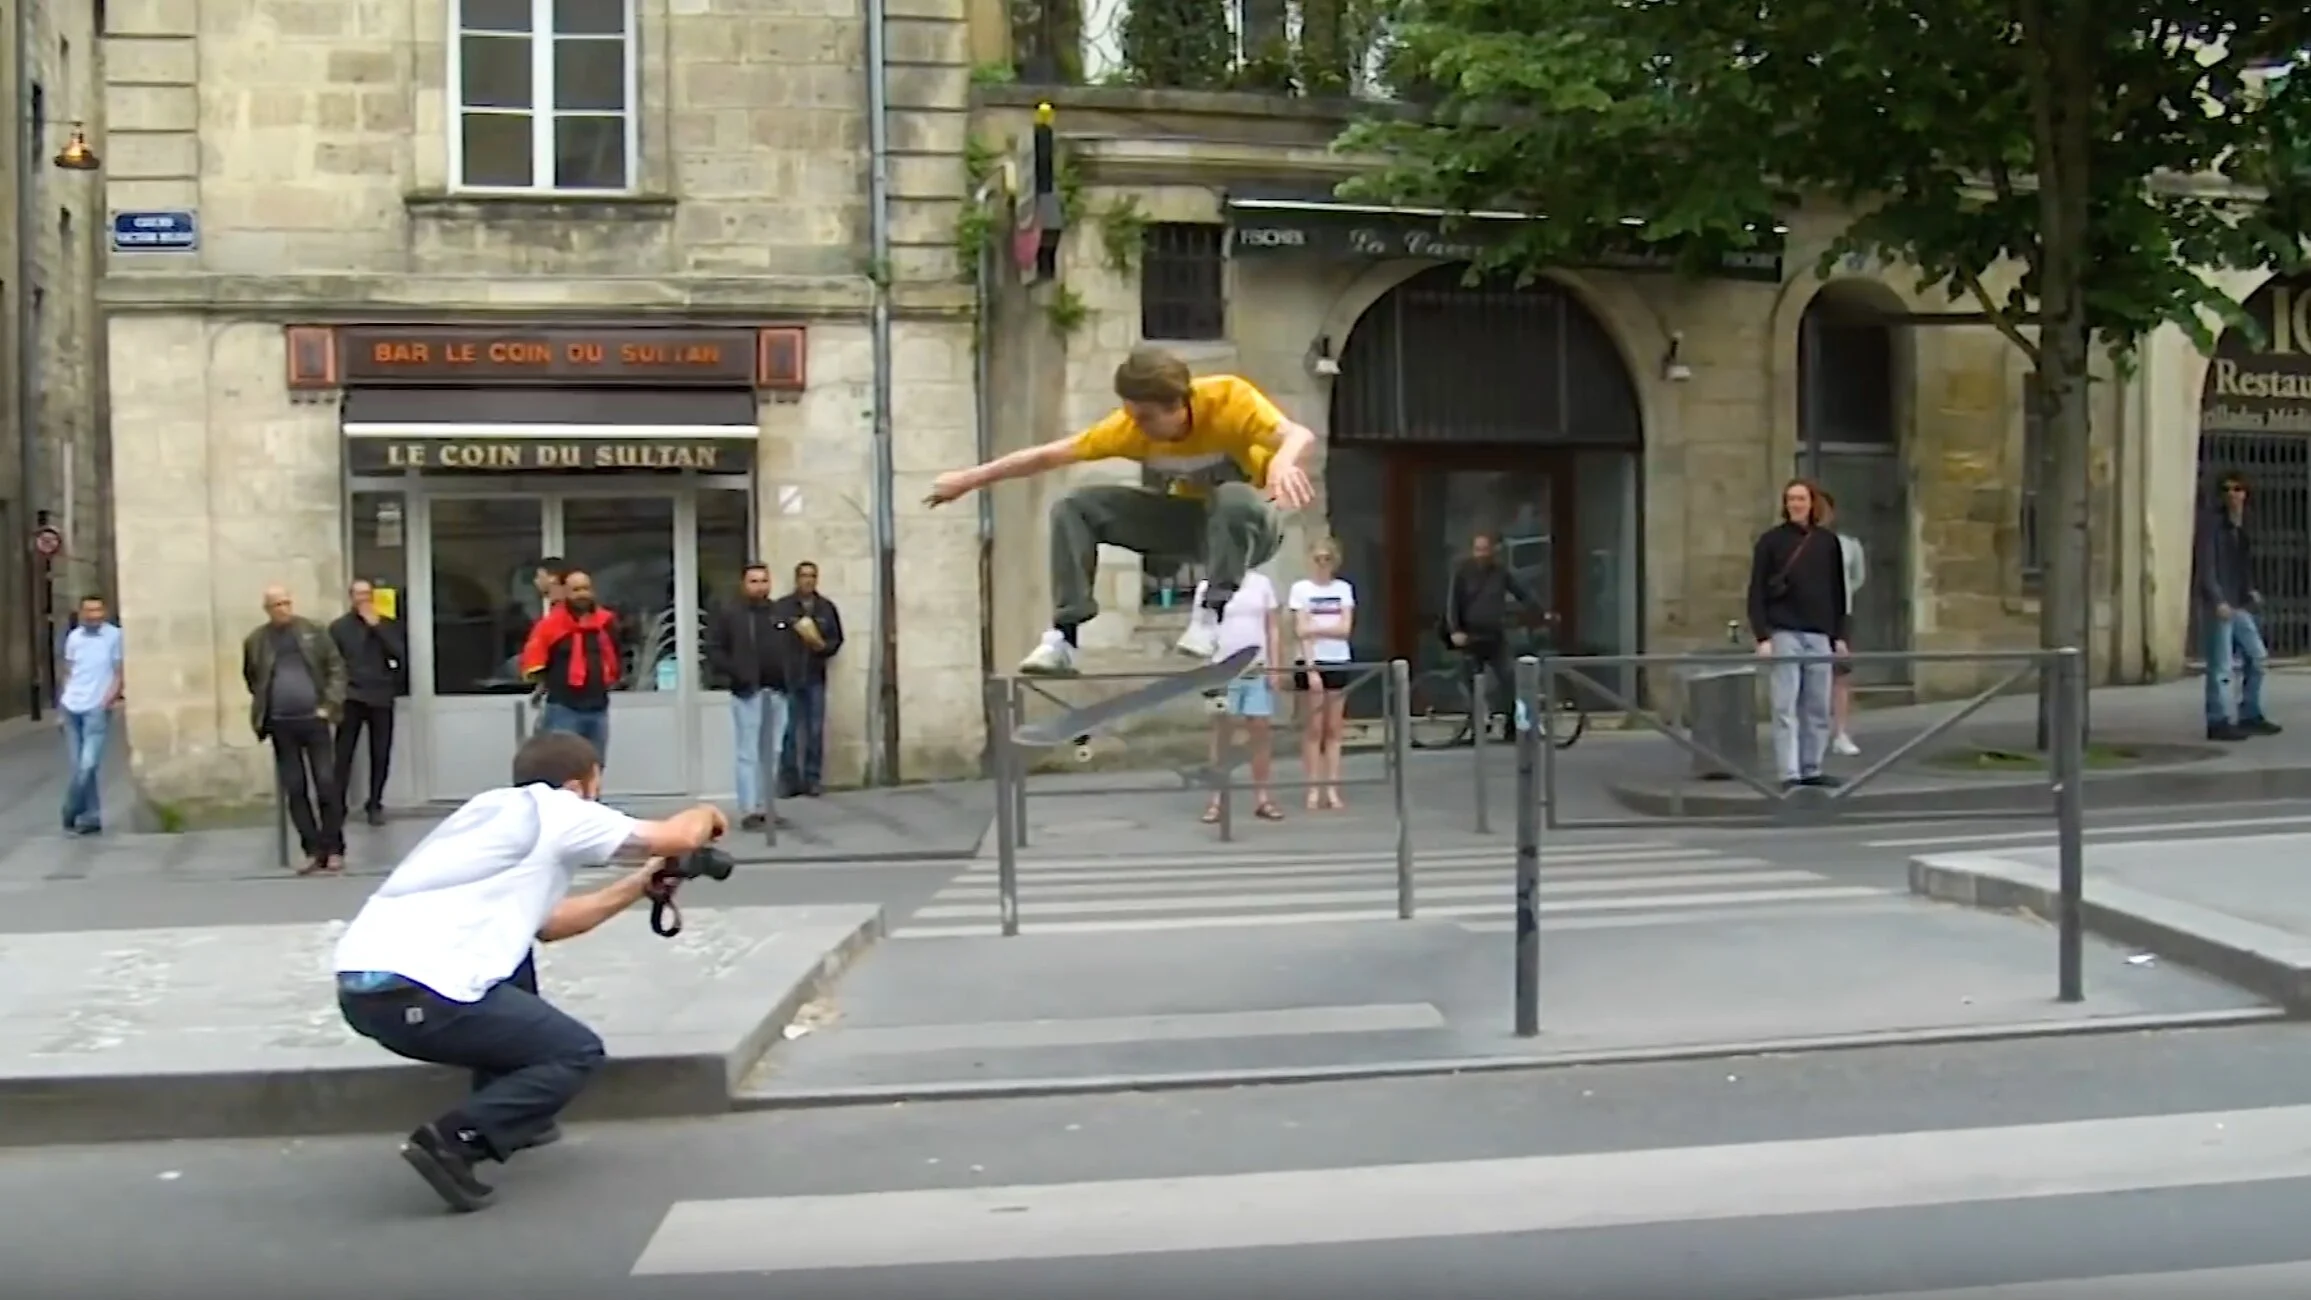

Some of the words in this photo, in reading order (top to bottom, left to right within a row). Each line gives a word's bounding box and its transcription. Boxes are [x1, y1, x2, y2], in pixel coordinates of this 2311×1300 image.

[374, 343, 429, 362] BAR
[445, 343, 476, 362] LE
[488, 343, 552, 362] COIN
[567, 343, 604, 362] DU
[620, 343, 719, 362] SULTAN
[388, 445, 425, 466] LE
[439, 445, 522, 466] COIN
[536, 445, 581, 466] DU
[595, 445, 718, 467] SULTAN
